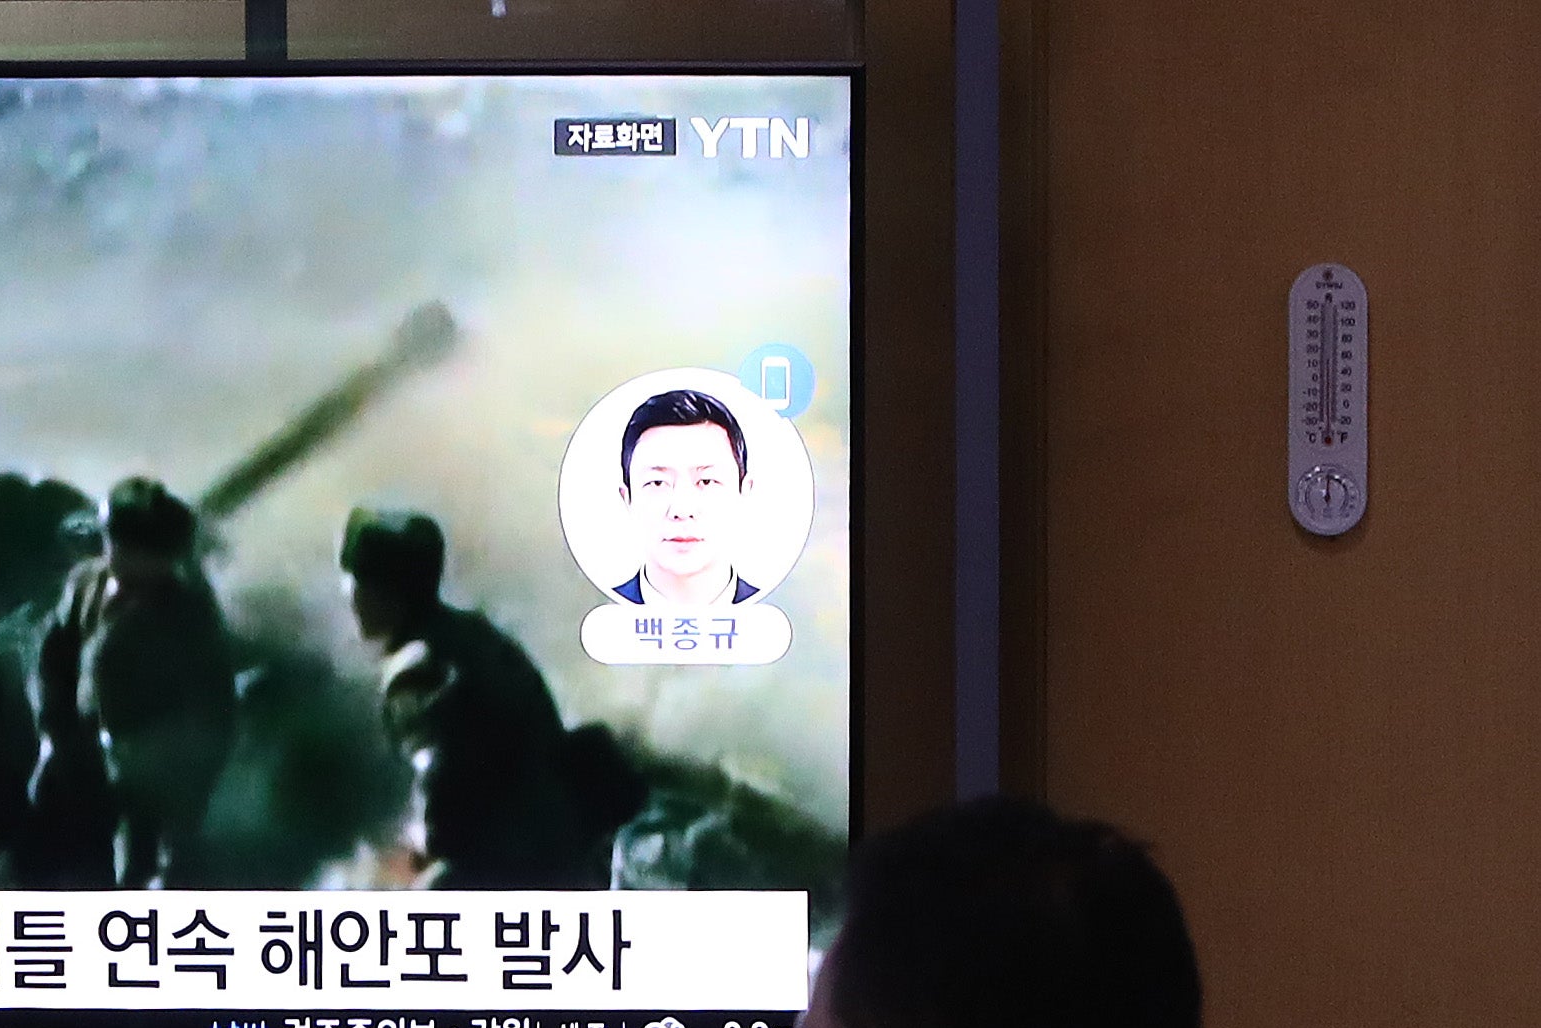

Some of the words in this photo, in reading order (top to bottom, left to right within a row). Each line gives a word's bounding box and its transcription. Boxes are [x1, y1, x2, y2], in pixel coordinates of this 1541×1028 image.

[567, 122, 664, 153] 자료화면
[690, 117, 810, 158] YTN
[634, 617, 739, 650] 백종규
[97, 908, 235, 990] 연속
[259, 908, 469, 990] 해안포
[493, 908, 632, 990] 발사
